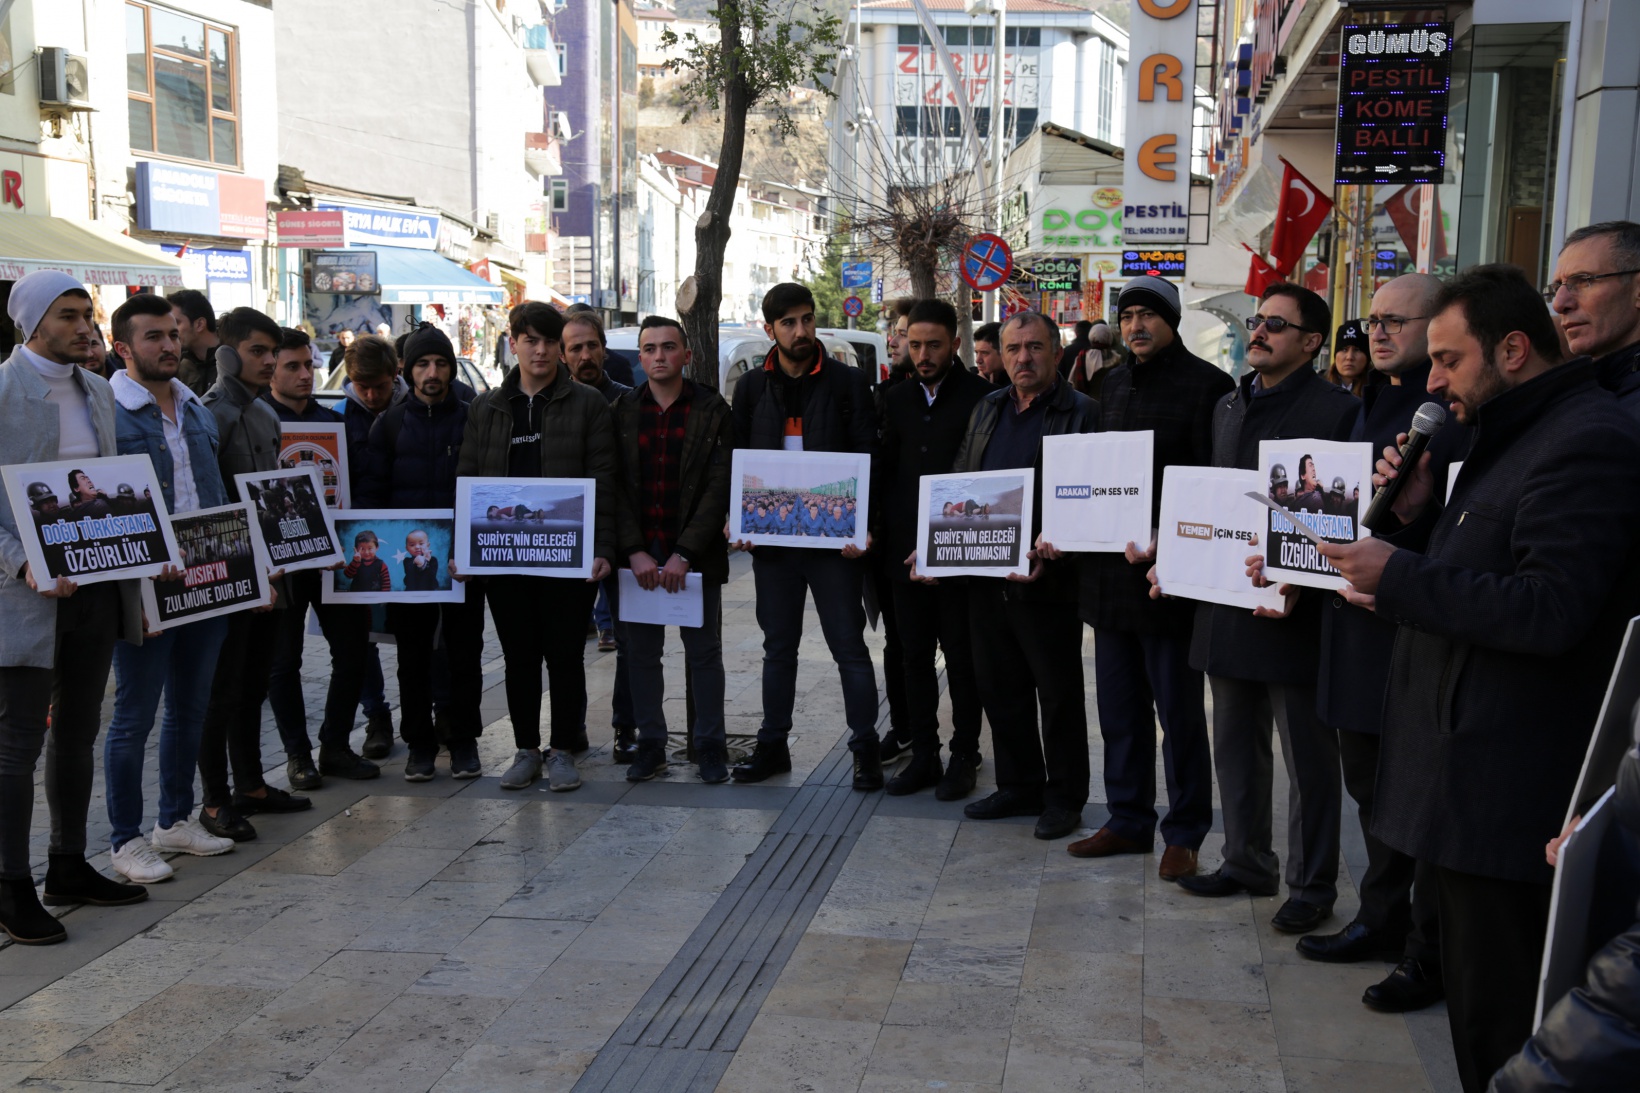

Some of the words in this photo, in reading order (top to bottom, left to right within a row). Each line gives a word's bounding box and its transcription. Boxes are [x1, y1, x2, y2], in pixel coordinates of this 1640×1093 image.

[1348, 29, 1447, 57] GÜMÜŞ
[1351, 64, 1442, 88] PESTİL
[1355, 96, 1433, 118] KÖME
[1355, 129, 1429, 147] BALLI
[1124, 201, 1188, 218] PESTİL
[1034, 260, 1078, 273] DOĞA
[1123, 260, 1152, 270] PESTİL
[1157, 261, 1185, 270] KÖME
[137, 273, 158, 286] 213
[1039, 280, 1073, 290] KÖME
[1057, 487, 1089, 496] ARAKAN
[1108, 487, 1122, 496] SES
[1123, 487, 1139, 496] VER
[41, 518, 79, 545] DOĞU
[77, 512, 157, 540] TÜRKİSTAN'A
[934, 528, 978, 545] SURİYE'NİN
[979, 526, 1016, 544] GELECEĞİ
[1179, 524, 1211, 537] YEMEN
[1235, 530, 1252, 541] SES
[477, 530, 530, 547] SURİYE'NİN
[532, 531, 577, 547] GELECEĞİ
[63, 537, 152, 573] ÖZGÜRLÜK!
[268, 540, 295, 561] ÖZGÜR
[292, 538, 316, 556] OLANA
[313, 535, 331, 552] DEK!
[481, 548, 514, 562] KIYIYA
[516, 548, 572, 562] VURMASIN!
[936, 546, 962, 561] KIYIYA
[964, 545, 1011, 561] VURMASIN!
[185, 561, 228, 587] MISIR'IN
[164, 586, 214, 614] ZULMÜNE
[214, 582, 235, 602] DUR
[235, 578, 253, 598] DE!
